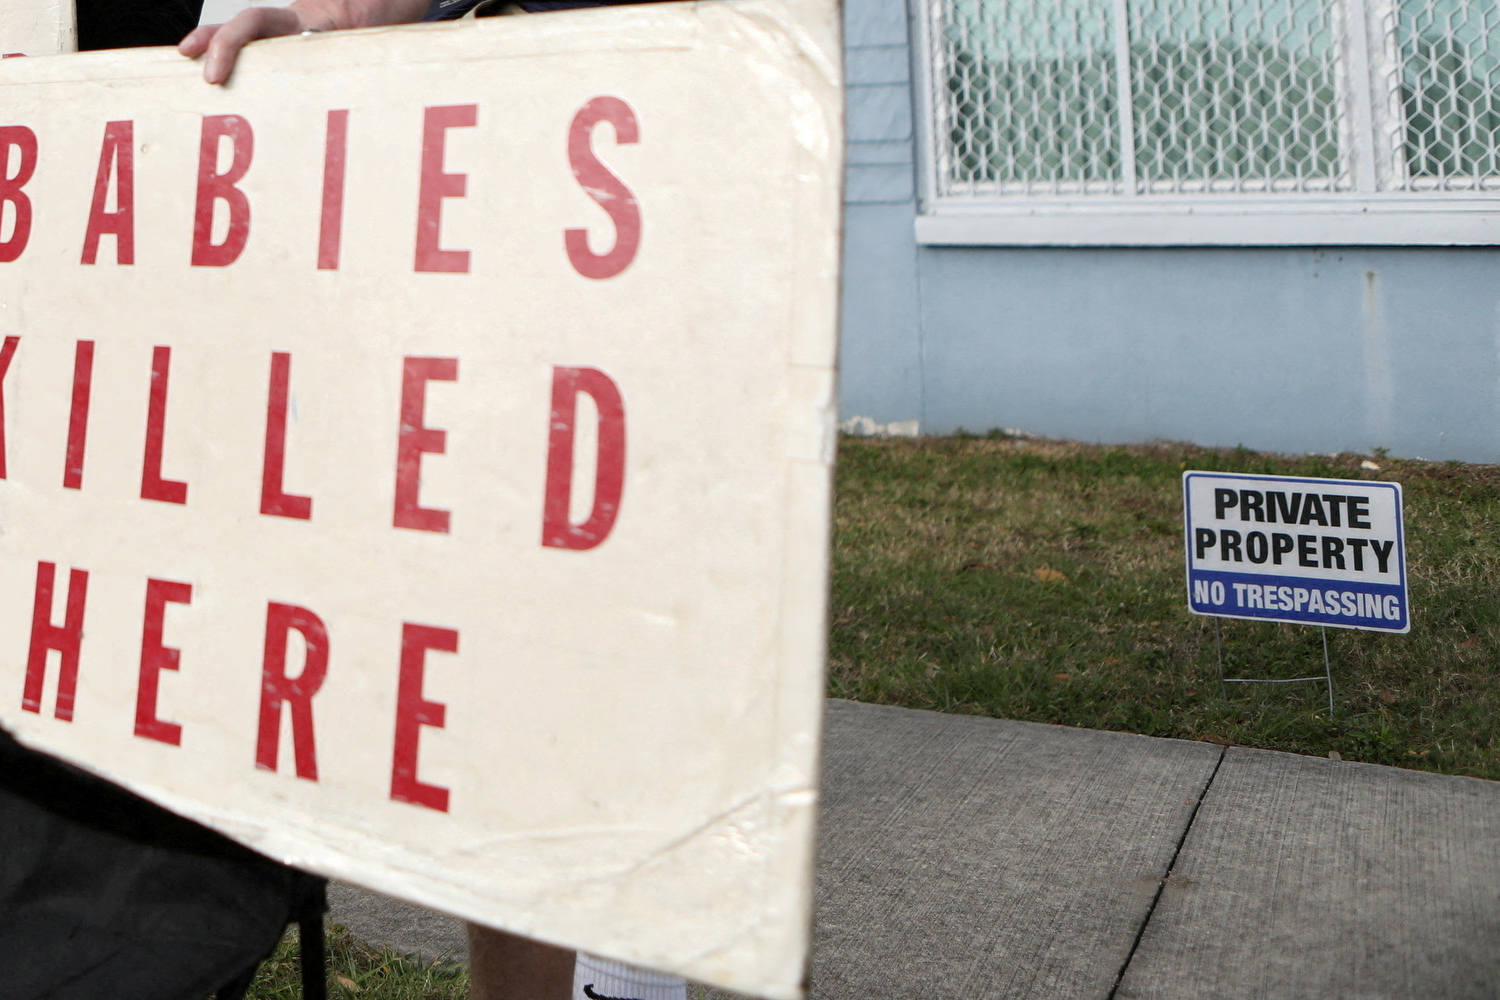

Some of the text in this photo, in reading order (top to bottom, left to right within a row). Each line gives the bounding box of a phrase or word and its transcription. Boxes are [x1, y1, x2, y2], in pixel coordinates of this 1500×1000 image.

[1214, 488, 1372, 530] PRIVATE
[1195, 528, 1394, 573] PROPERTY
[1194, 580, 1400, 621] NO TRESPASSING
[21, 560, 460, 813] HERE
